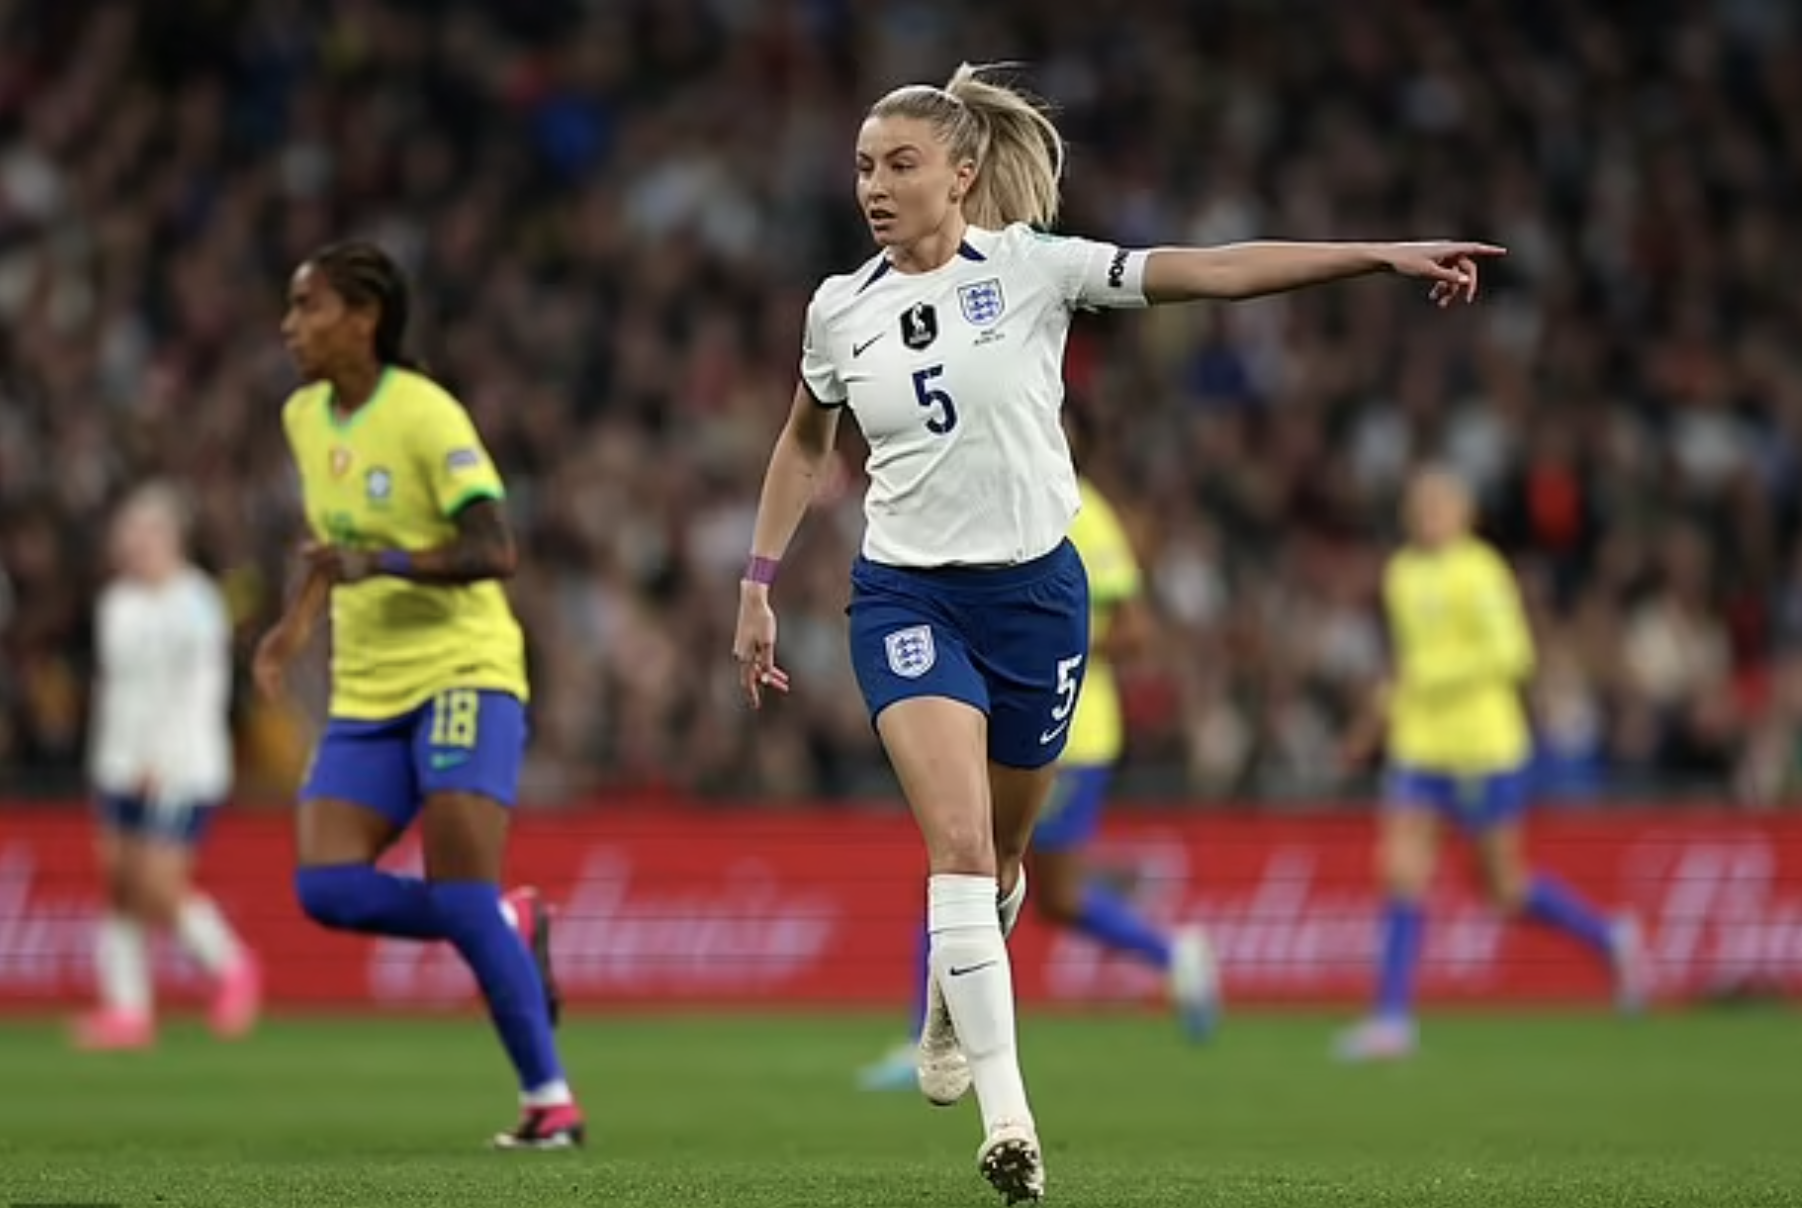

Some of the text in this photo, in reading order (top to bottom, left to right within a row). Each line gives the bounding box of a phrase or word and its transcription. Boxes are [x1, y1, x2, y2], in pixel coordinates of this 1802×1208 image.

[912, 364, 957, 435] 5
[429, 690, 478, 750] 18
[1051, 653, 1083, 721] 5
